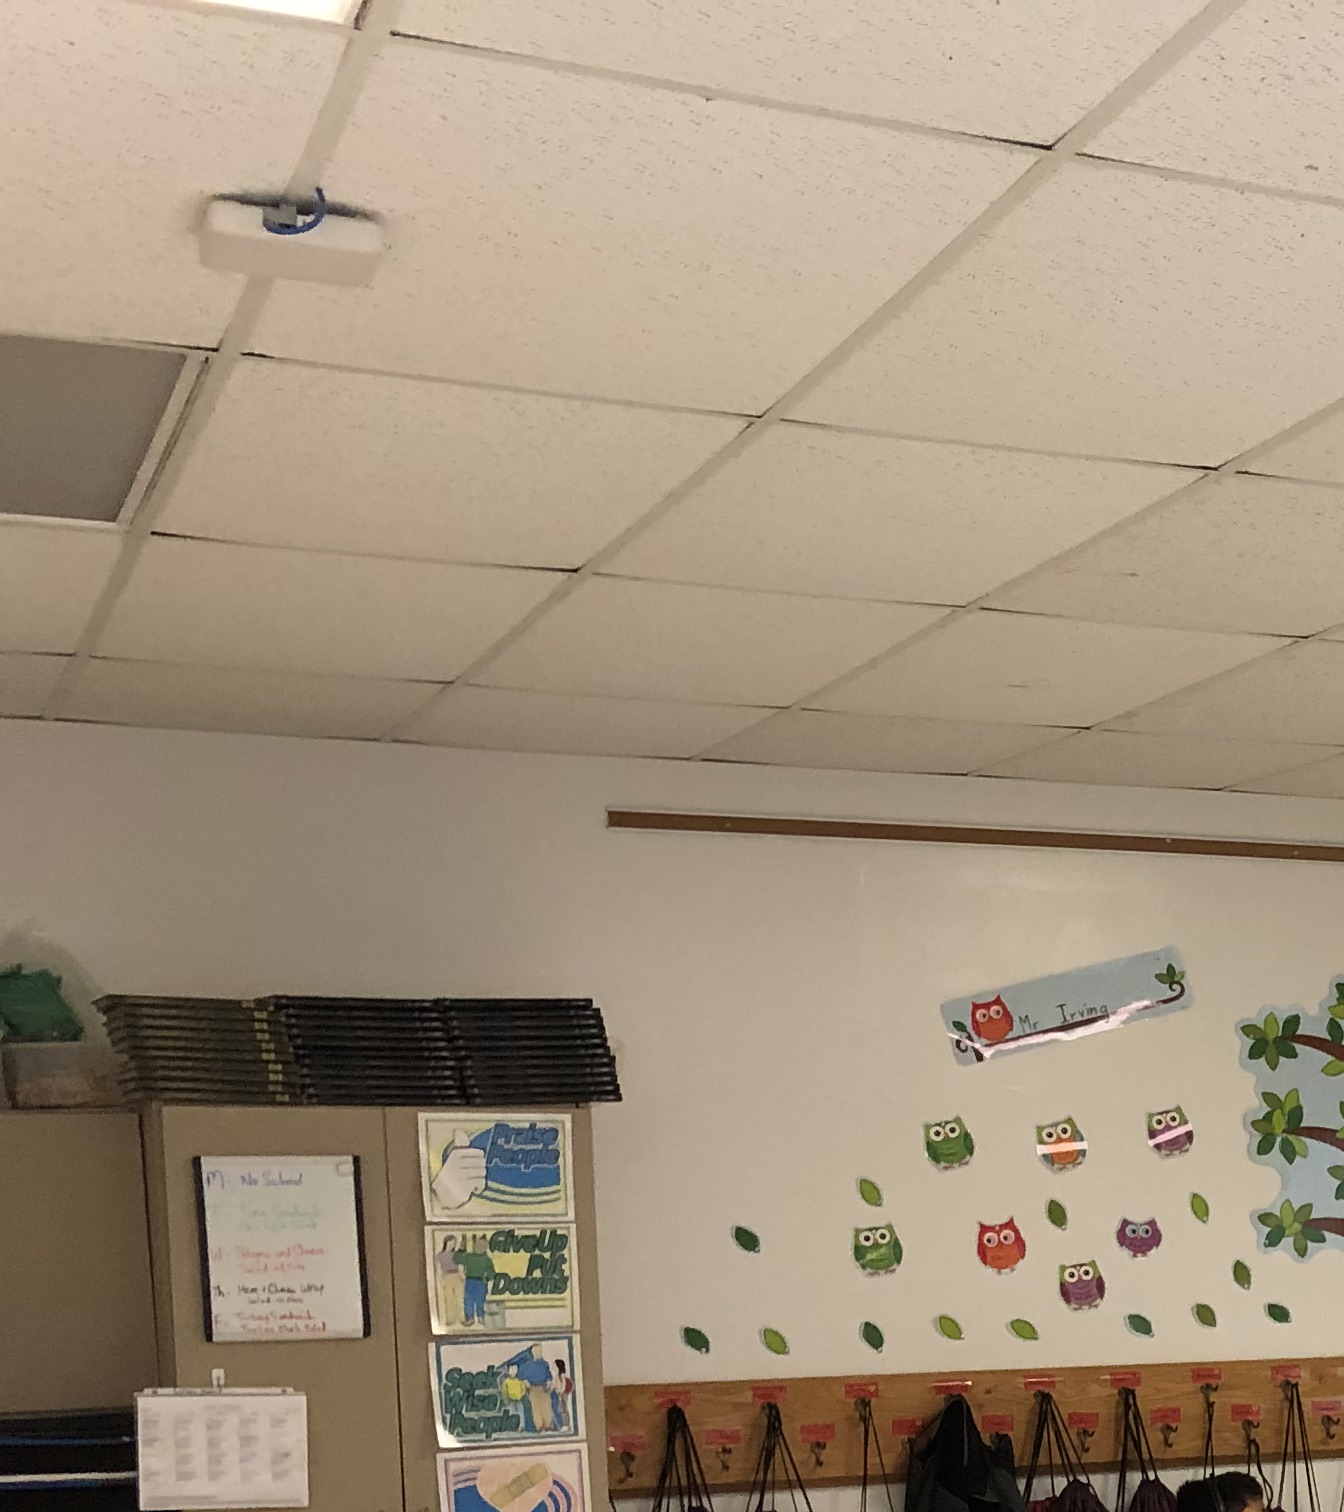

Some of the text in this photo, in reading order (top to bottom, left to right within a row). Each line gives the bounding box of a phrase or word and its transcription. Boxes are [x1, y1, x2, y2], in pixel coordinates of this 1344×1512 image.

[1018, 1003, 1110, 1033] Mr Irving
[494, 1122, 559, 1147] Praise
[487, 1148, 561, 1171] People
[526, 1252, 568, 1276] Put
[491, 1272, 569, 1296] Downs
[443, 1365, 500, 1391] Seek
[444, 1389, 499, 1413] Wise
[448, 1409, 521, 1439] People
